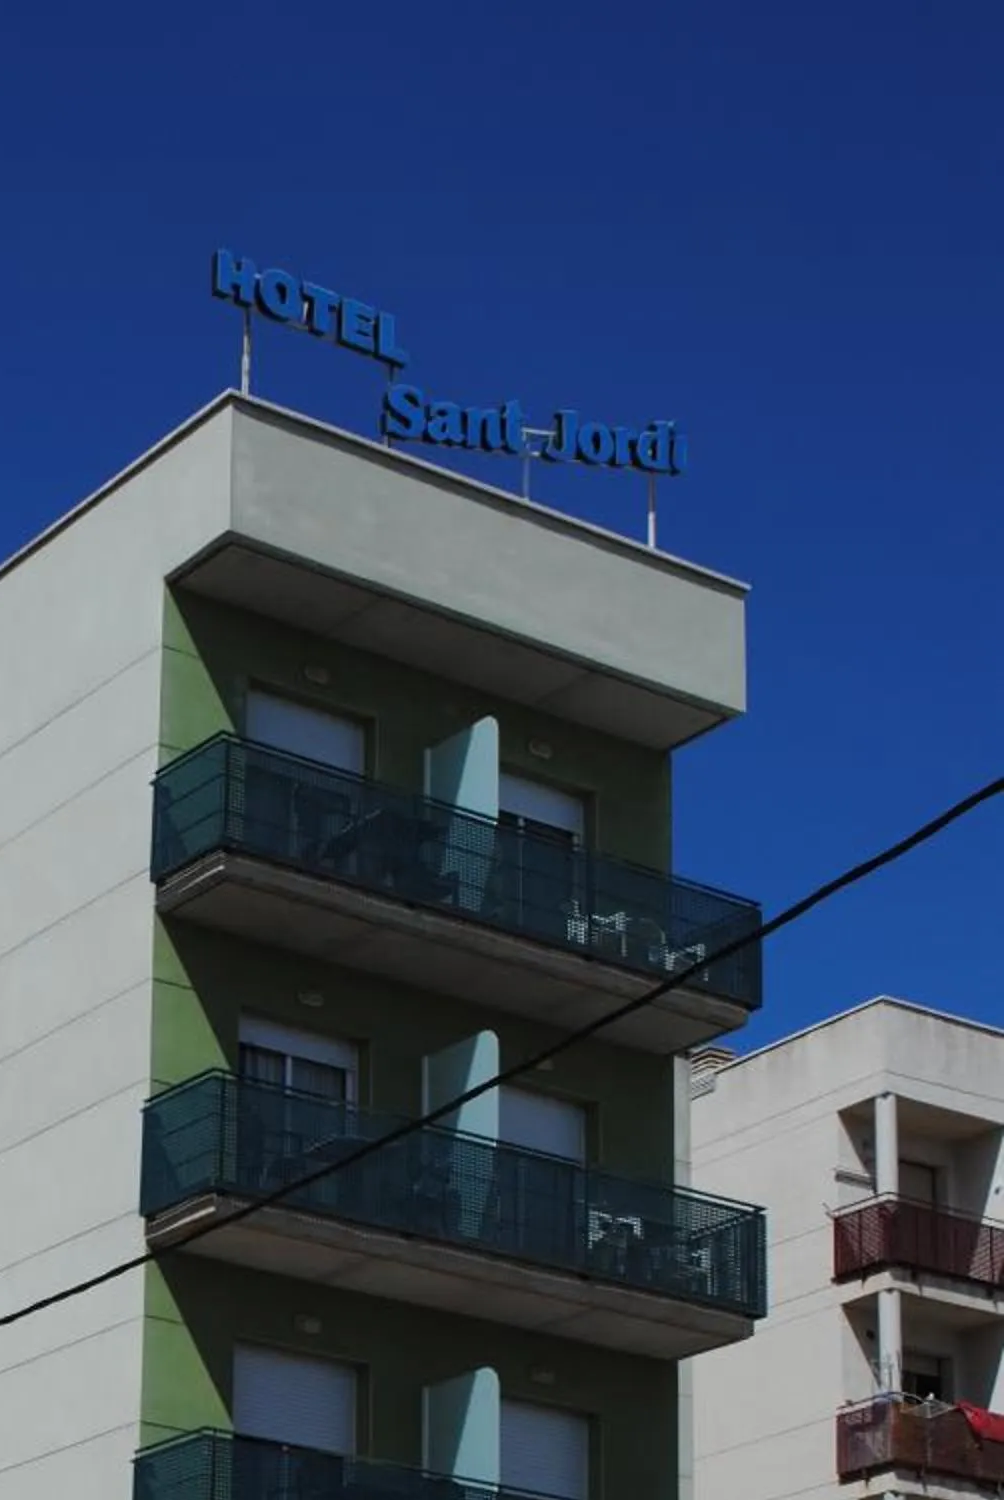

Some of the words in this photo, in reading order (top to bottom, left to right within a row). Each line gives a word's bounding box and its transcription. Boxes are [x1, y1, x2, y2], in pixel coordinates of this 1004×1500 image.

[211, 248, 408, 369] HOTEL
[382, 383, 524, 455] Sant
[541, 409, 688, 476] Jordi
